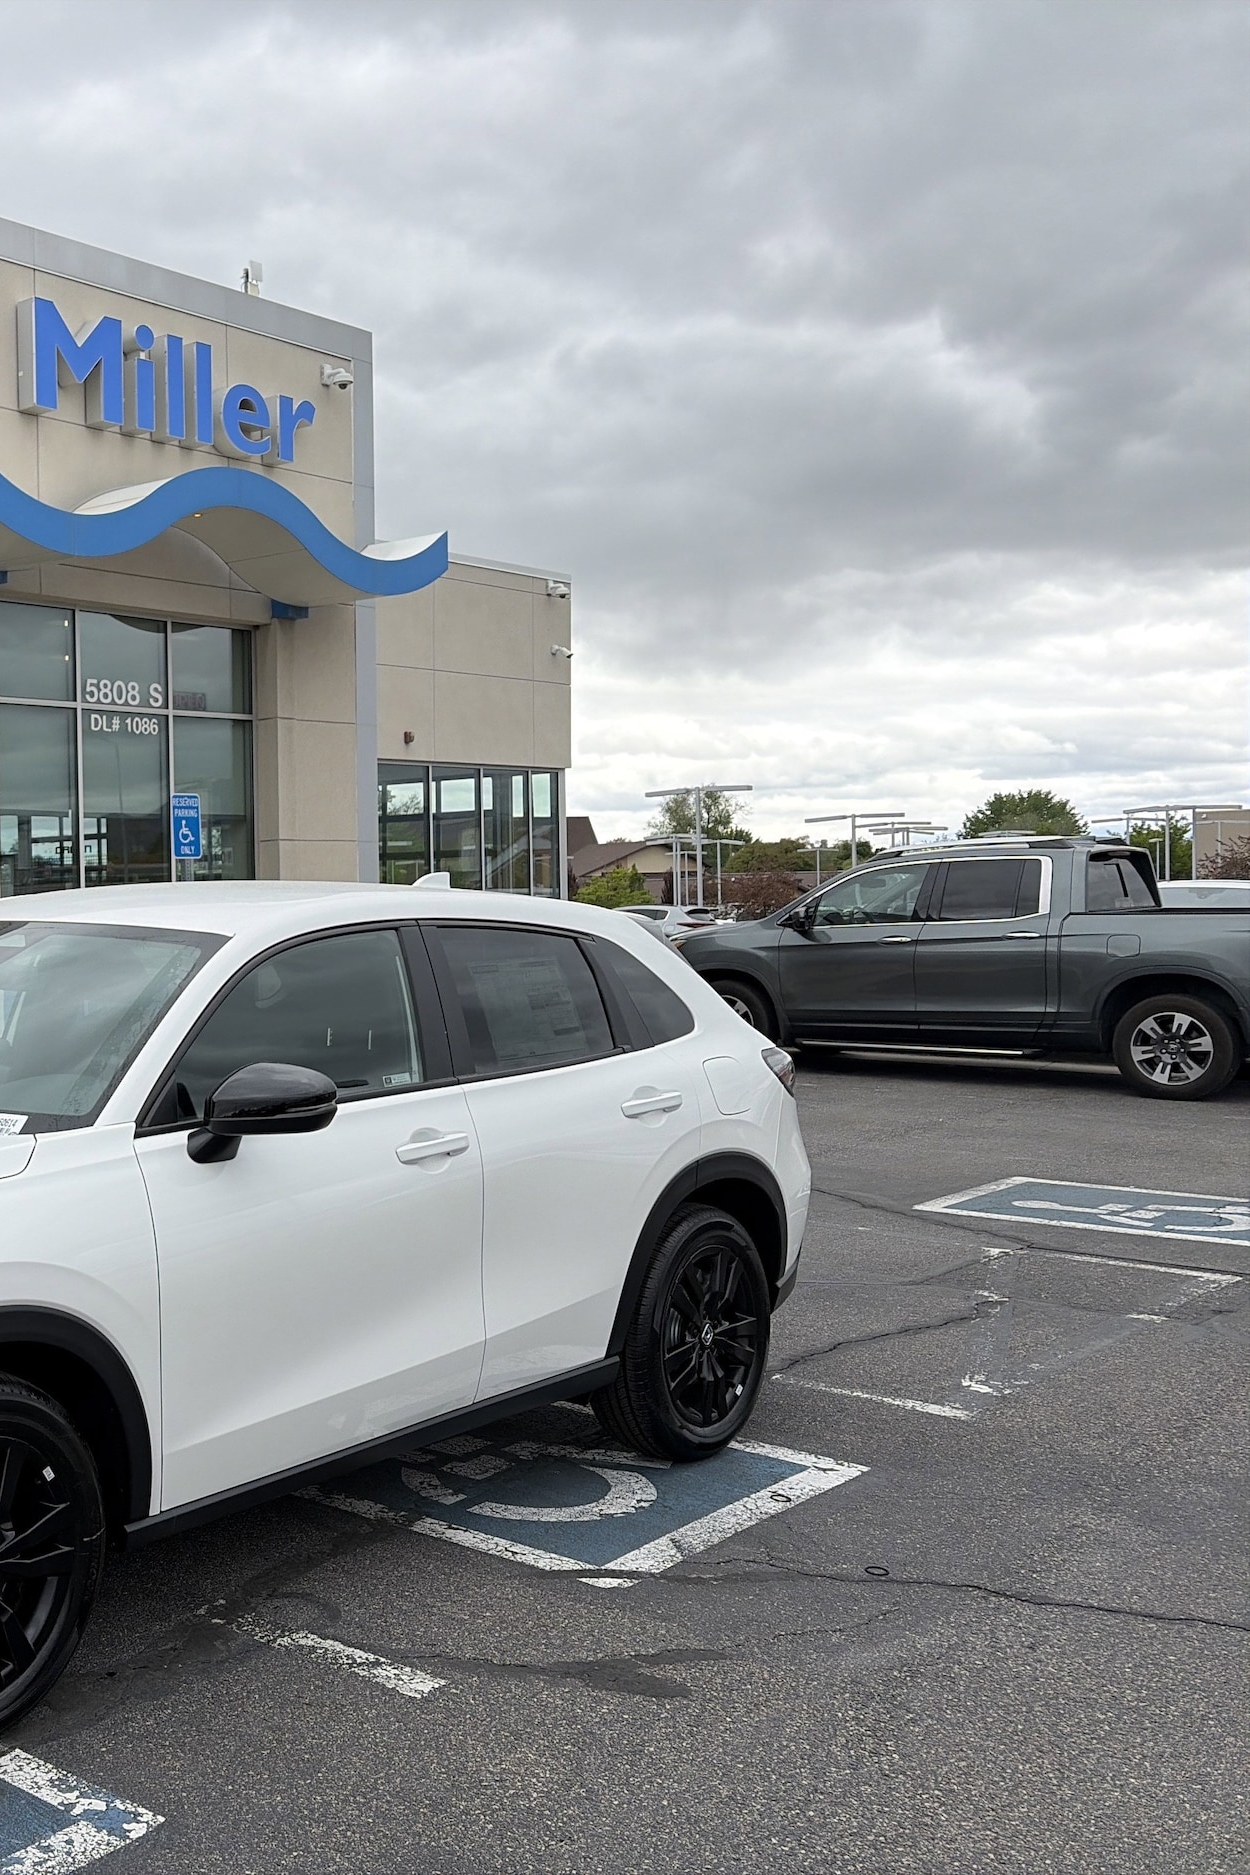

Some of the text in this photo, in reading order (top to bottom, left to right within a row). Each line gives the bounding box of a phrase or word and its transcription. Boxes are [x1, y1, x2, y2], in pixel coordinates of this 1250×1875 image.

[17, 296, 316, 464] Miller
[85, 678, 163, 708] 5808 S
[90, 713, 159, 735] DL# 1086
[172, 797, 198, 806] RESERVED
[174, 808, 198, 818] PARKING
[180, 845, 195, 855] ONLY
